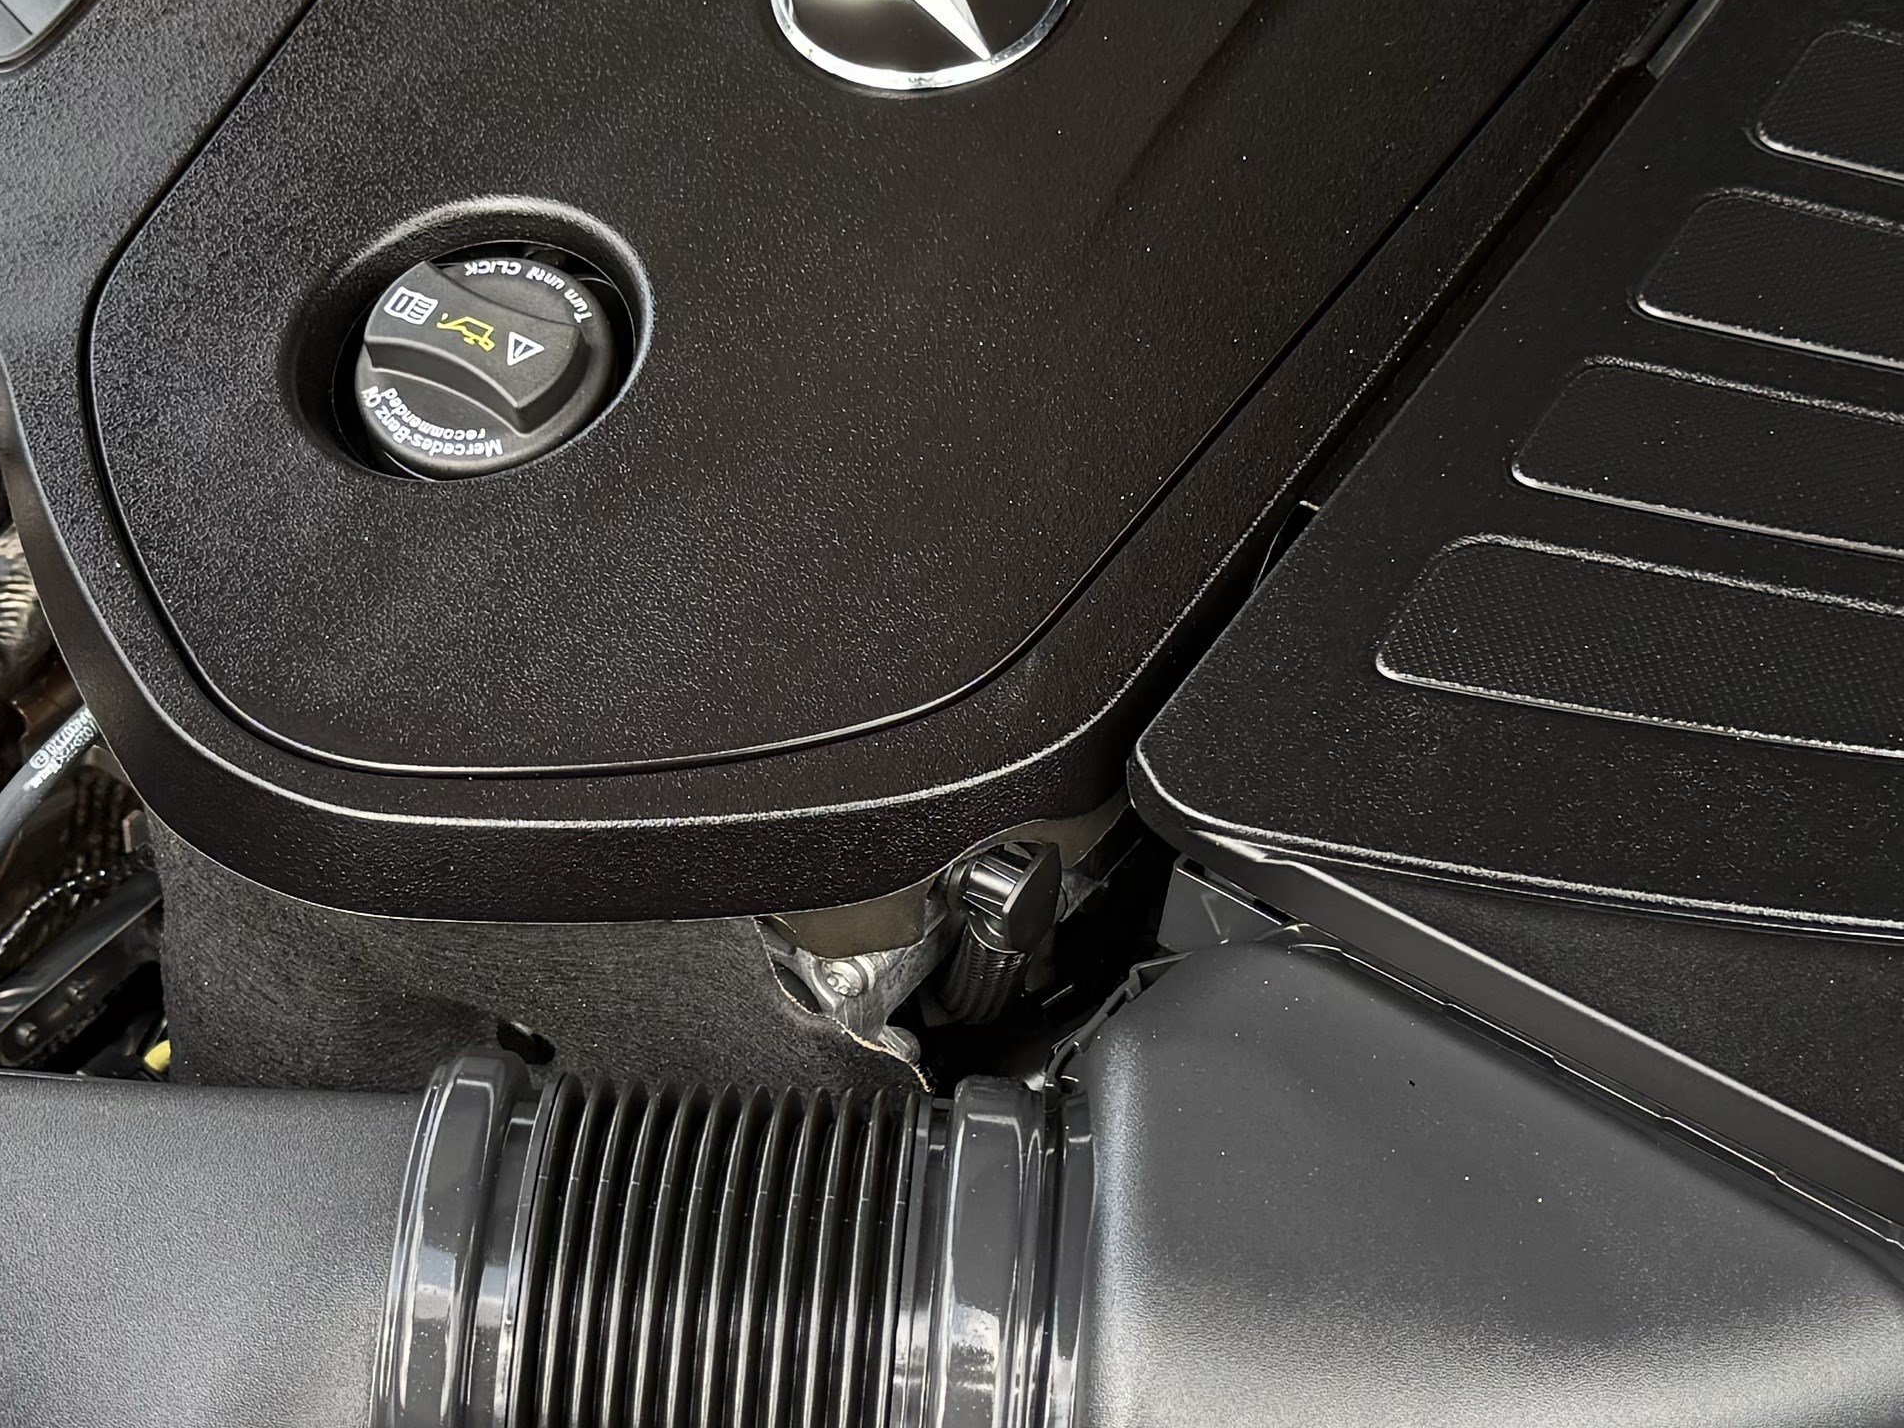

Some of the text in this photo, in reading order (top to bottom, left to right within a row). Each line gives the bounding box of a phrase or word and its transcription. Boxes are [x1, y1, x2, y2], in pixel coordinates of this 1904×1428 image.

[464, 260, 593, 324] Turn until CLICK
[375, 404, 504, 458] Mercedes-Benz
[380, 387, 487, 442] recommended
